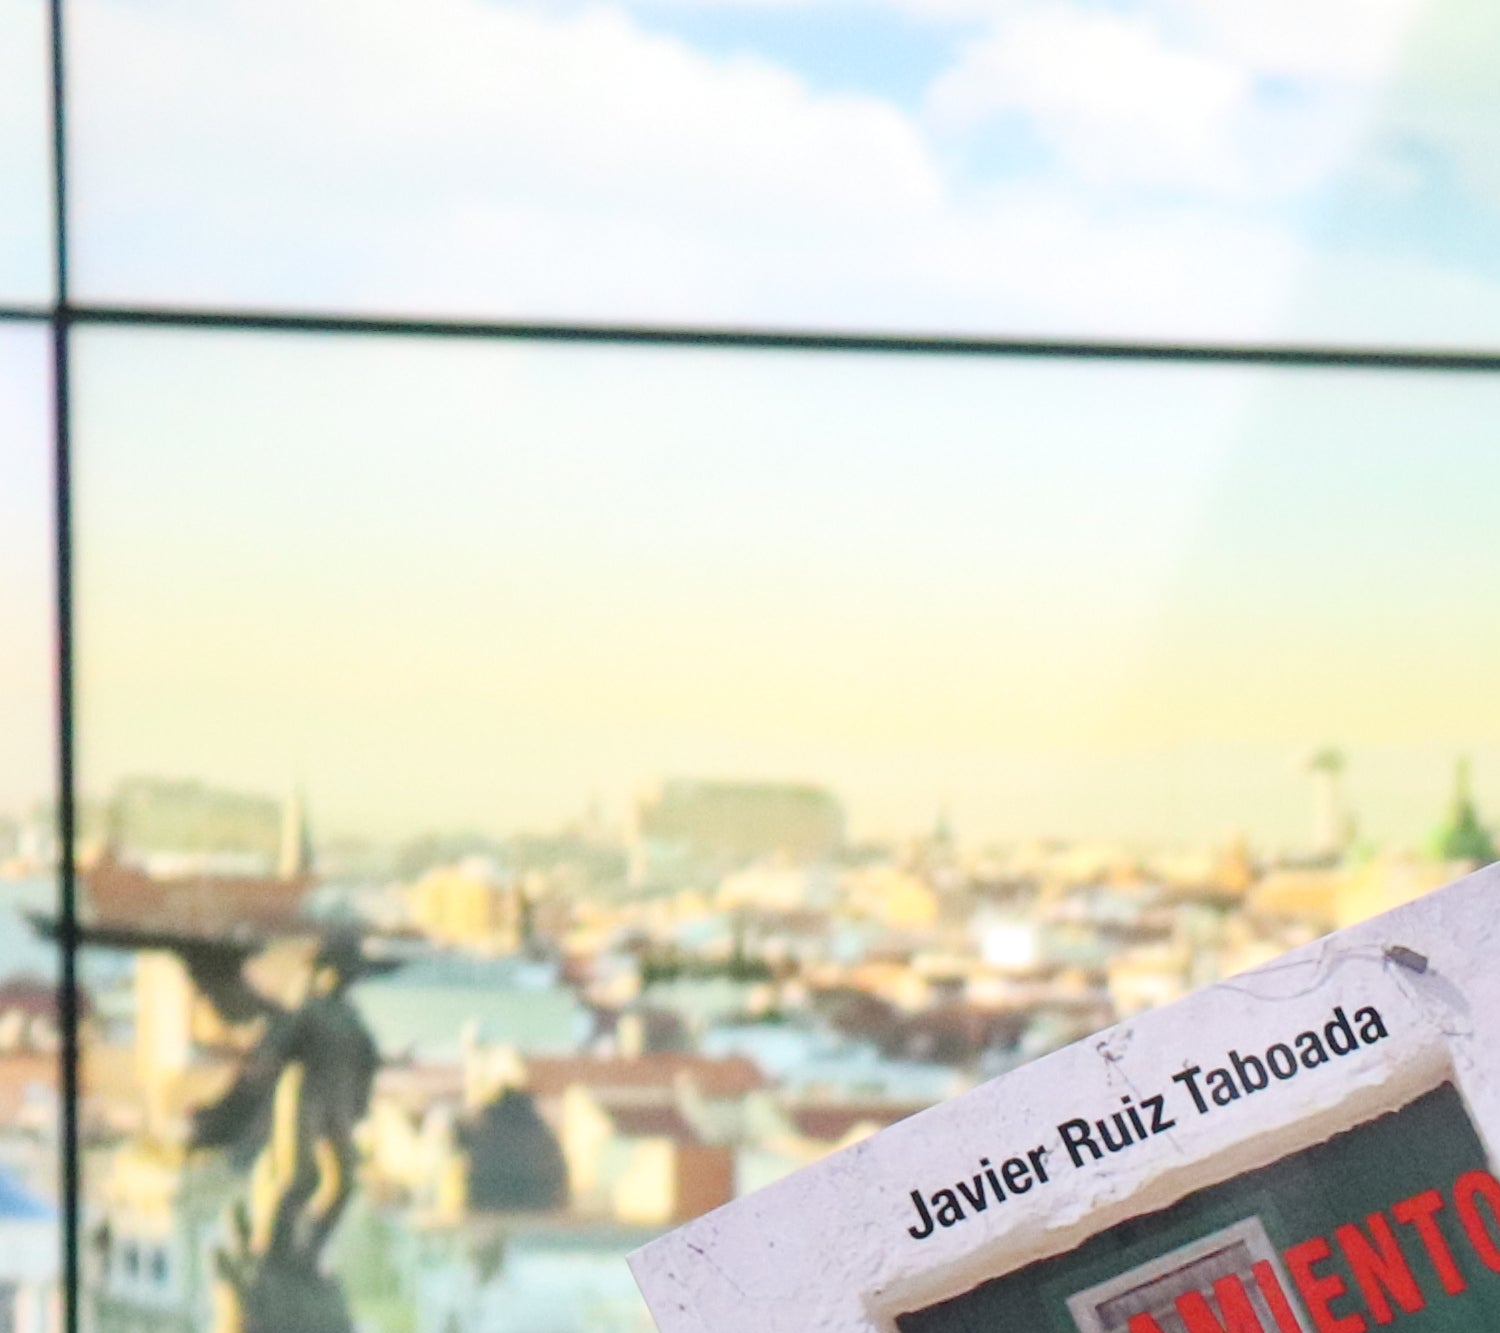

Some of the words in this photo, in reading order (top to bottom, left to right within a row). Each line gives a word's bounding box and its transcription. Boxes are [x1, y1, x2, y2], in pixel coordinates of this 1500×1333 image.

[907, 1144, 1050, 1239] Javier
[1056, 1094, 1175, 1168] Ruiz
[1172, 1006, 1389, 1114] Taboada
